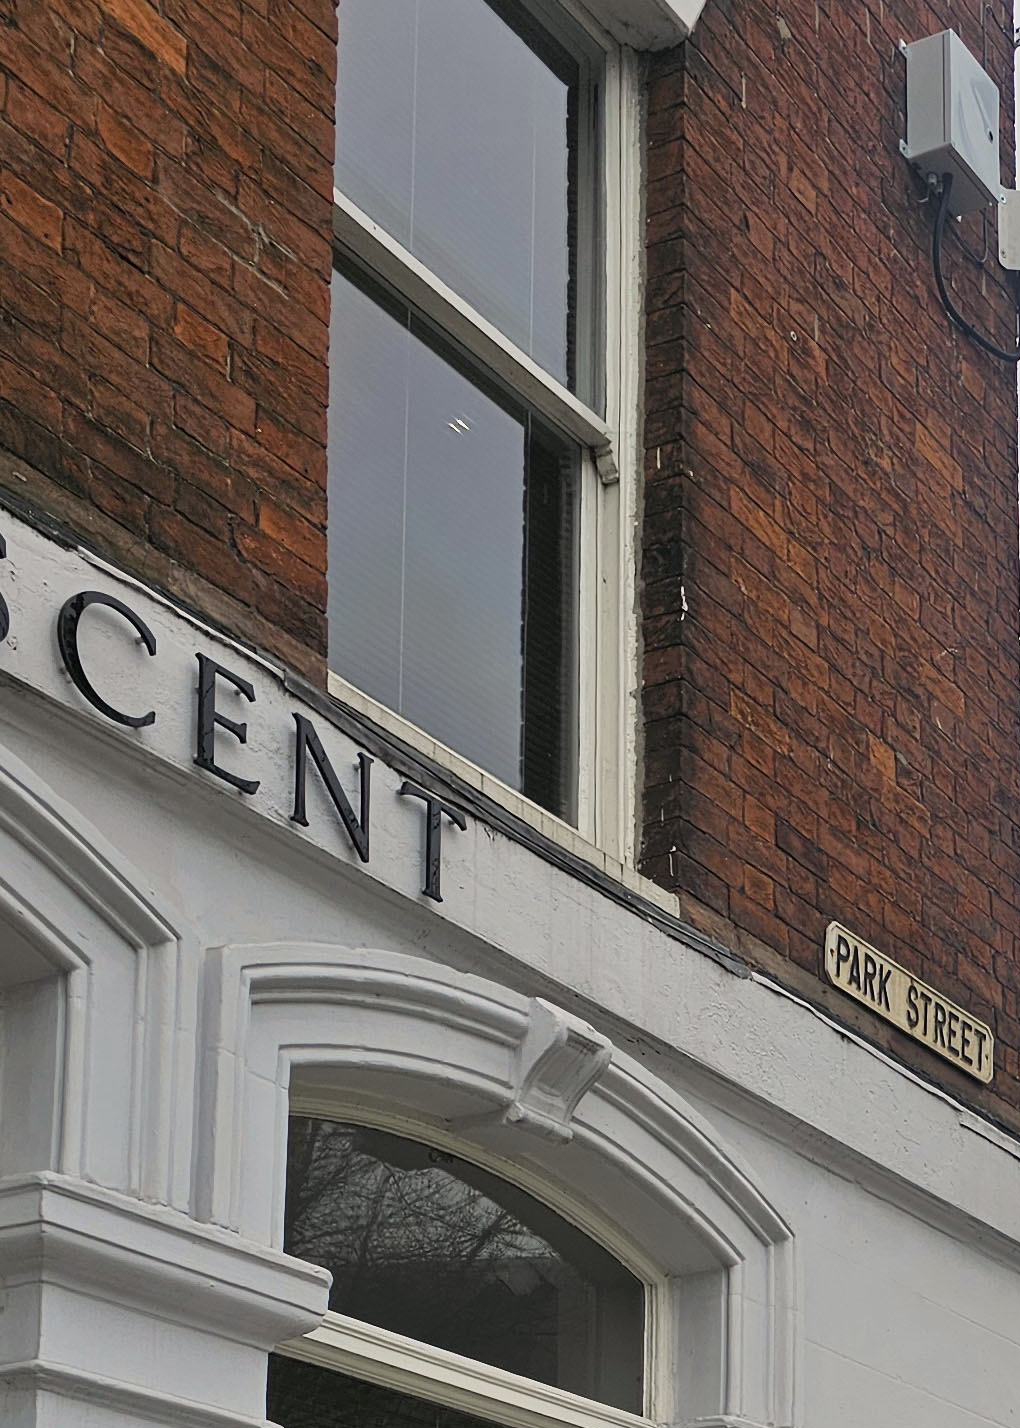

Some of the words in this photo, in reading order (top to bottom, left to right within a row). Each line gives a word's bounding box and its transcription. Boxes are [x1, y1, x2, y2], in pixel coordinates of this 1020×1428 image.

[0, 531, 468, 903] CENT
[835, 934, 892, 1012] PARK
[906, 984, 987, 1073] STREET
